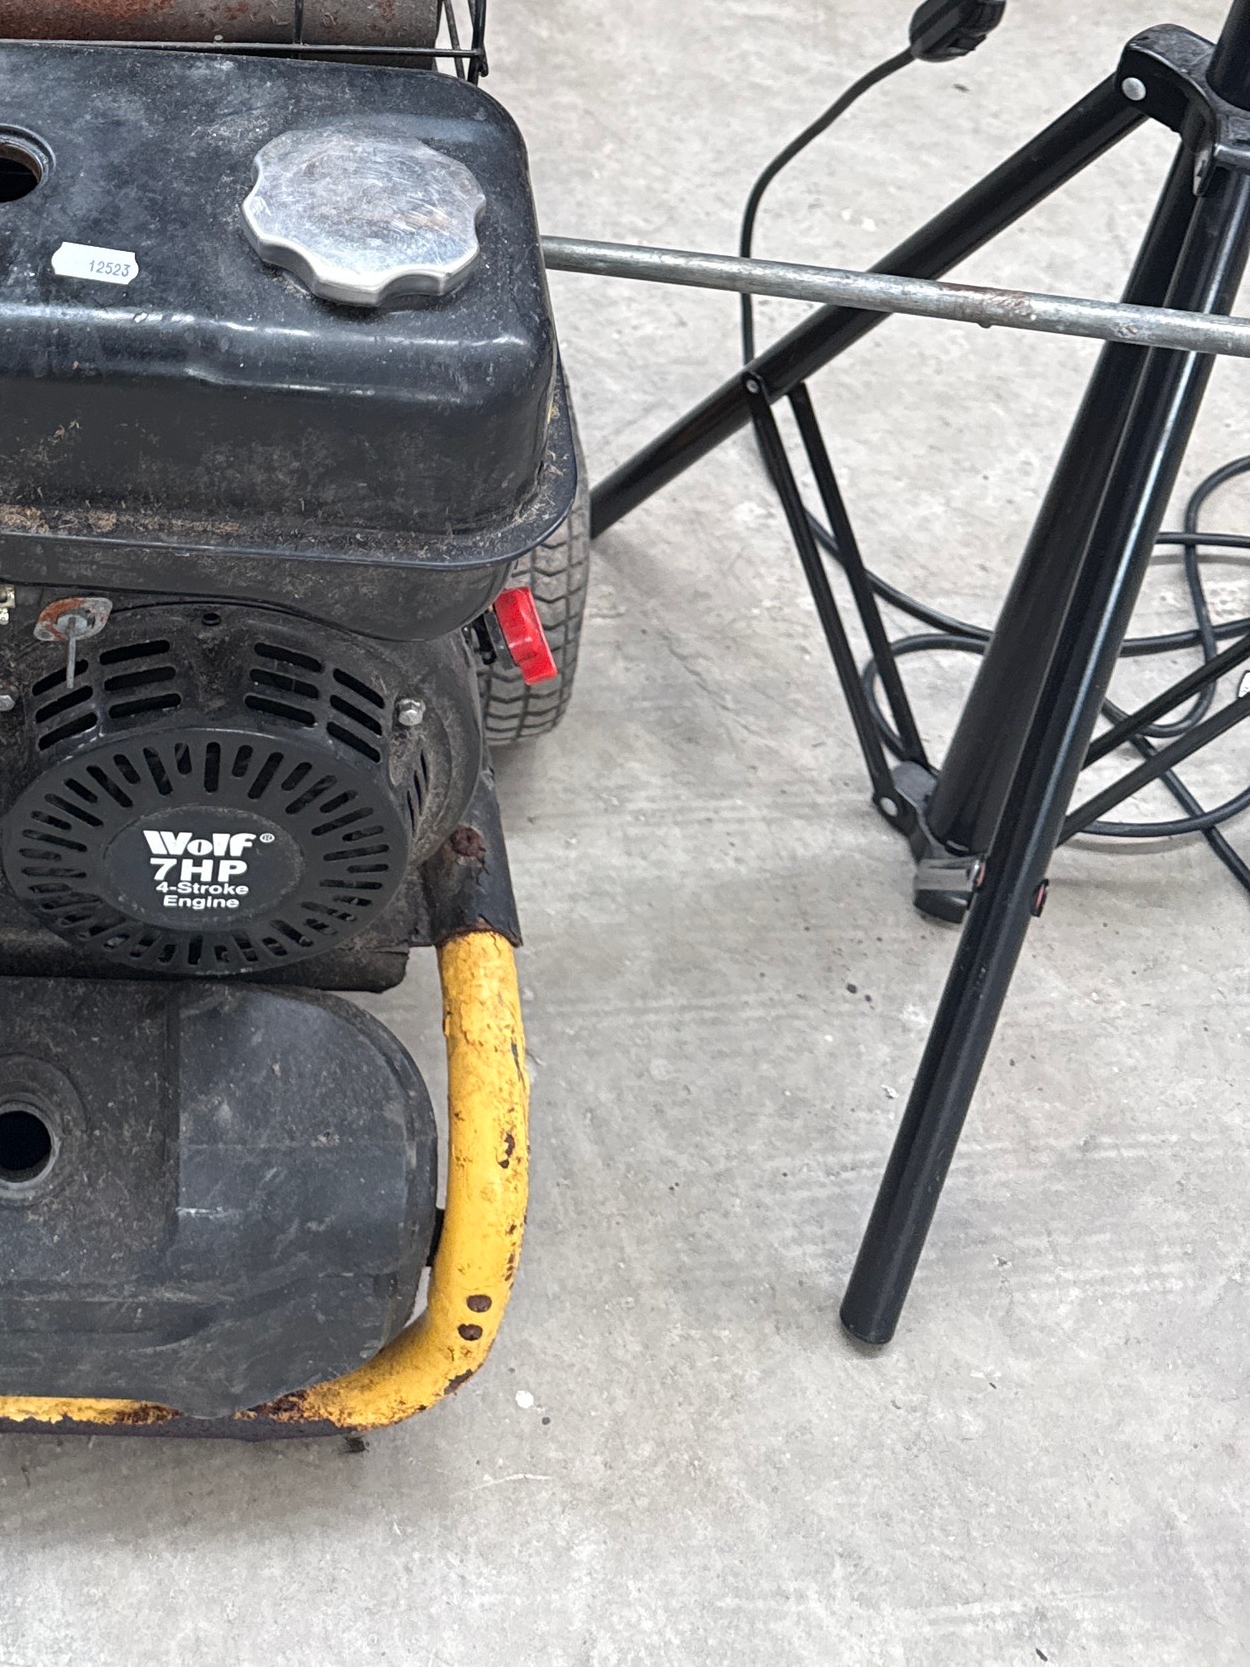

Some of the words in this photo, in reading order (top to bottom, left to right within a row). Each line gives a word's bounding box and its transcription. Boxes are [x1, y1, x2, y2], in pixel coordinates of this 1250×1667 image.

[88, 259, 132, 278] 12523
[143, 830, 257, 857] Wolf
[150, 857, 248, 882] 7HP
[155, 881, 249, 895] 4-Stroke
[163, 895, 240, 910] Engine
